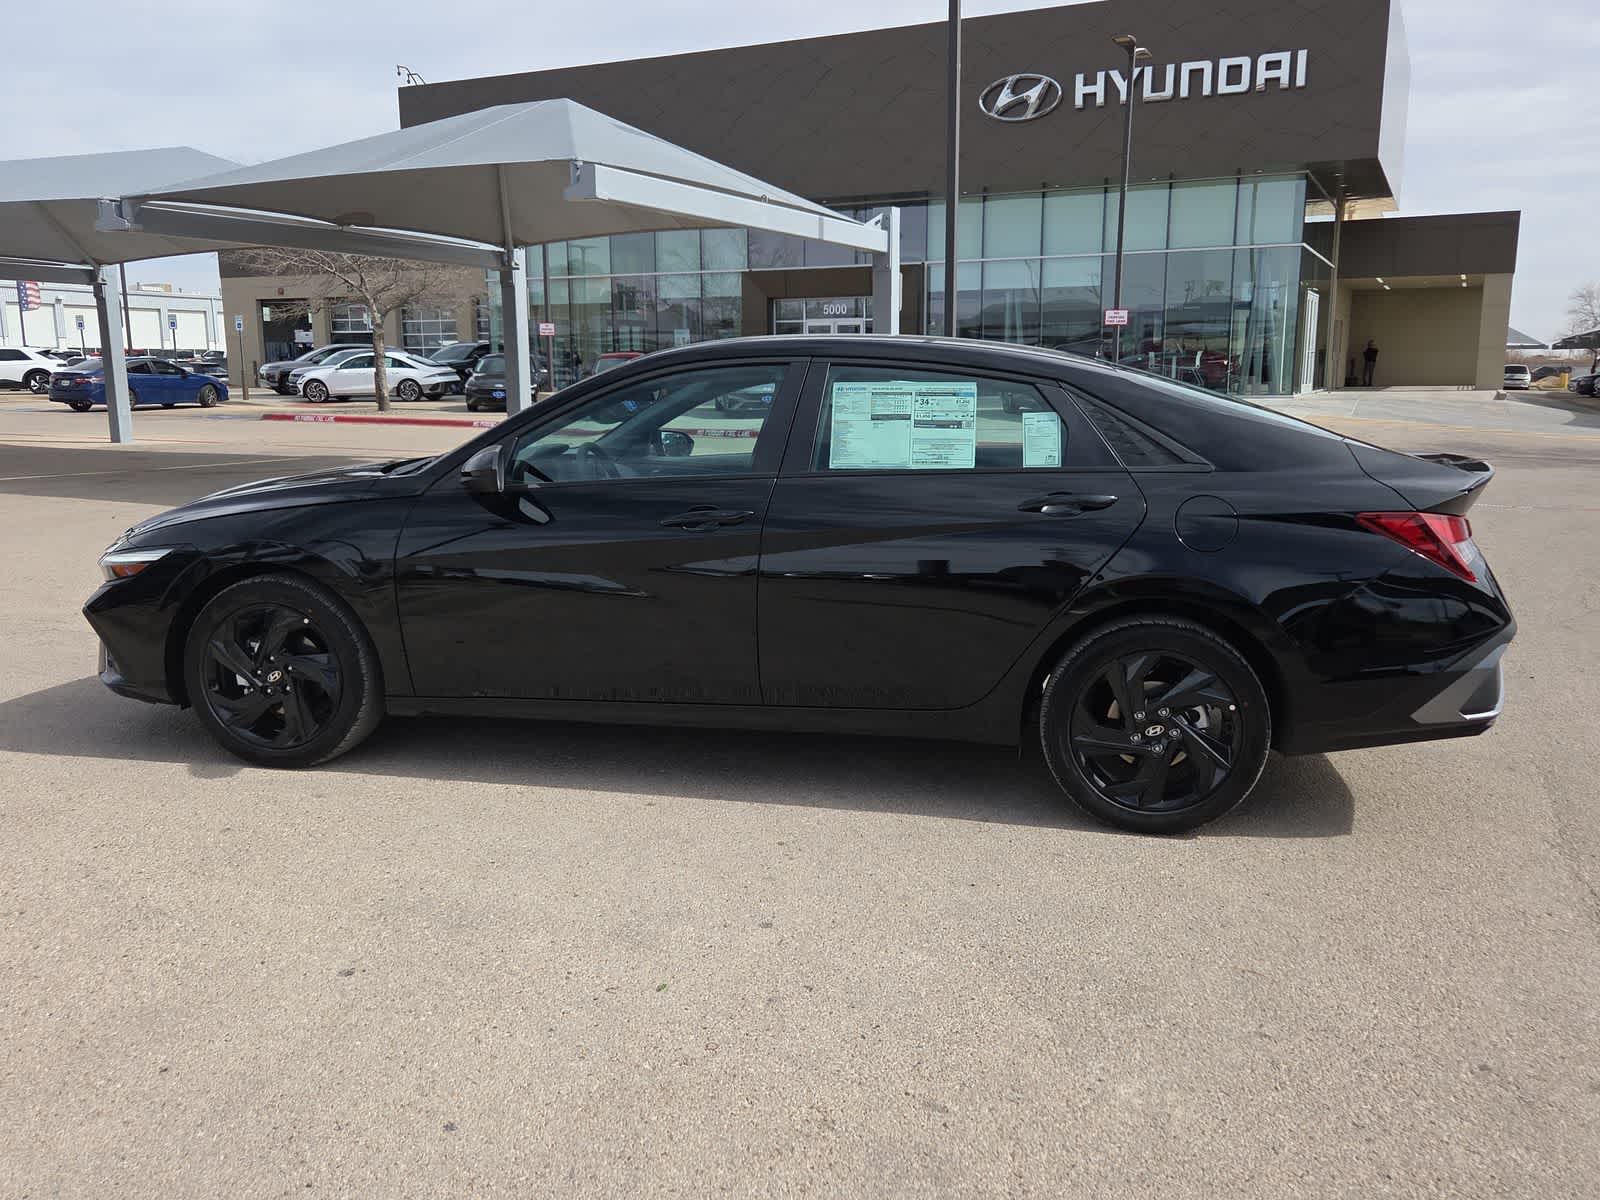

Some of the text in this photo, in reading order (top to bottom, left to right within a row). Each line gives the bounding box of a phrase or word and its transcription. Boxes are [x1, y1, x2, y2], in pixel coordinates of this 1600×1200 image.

[1073, 49, 1308, 109] HYUNDAI
[823, 304, 847, 315] 5000
[919, 398, 929, 406] 34
